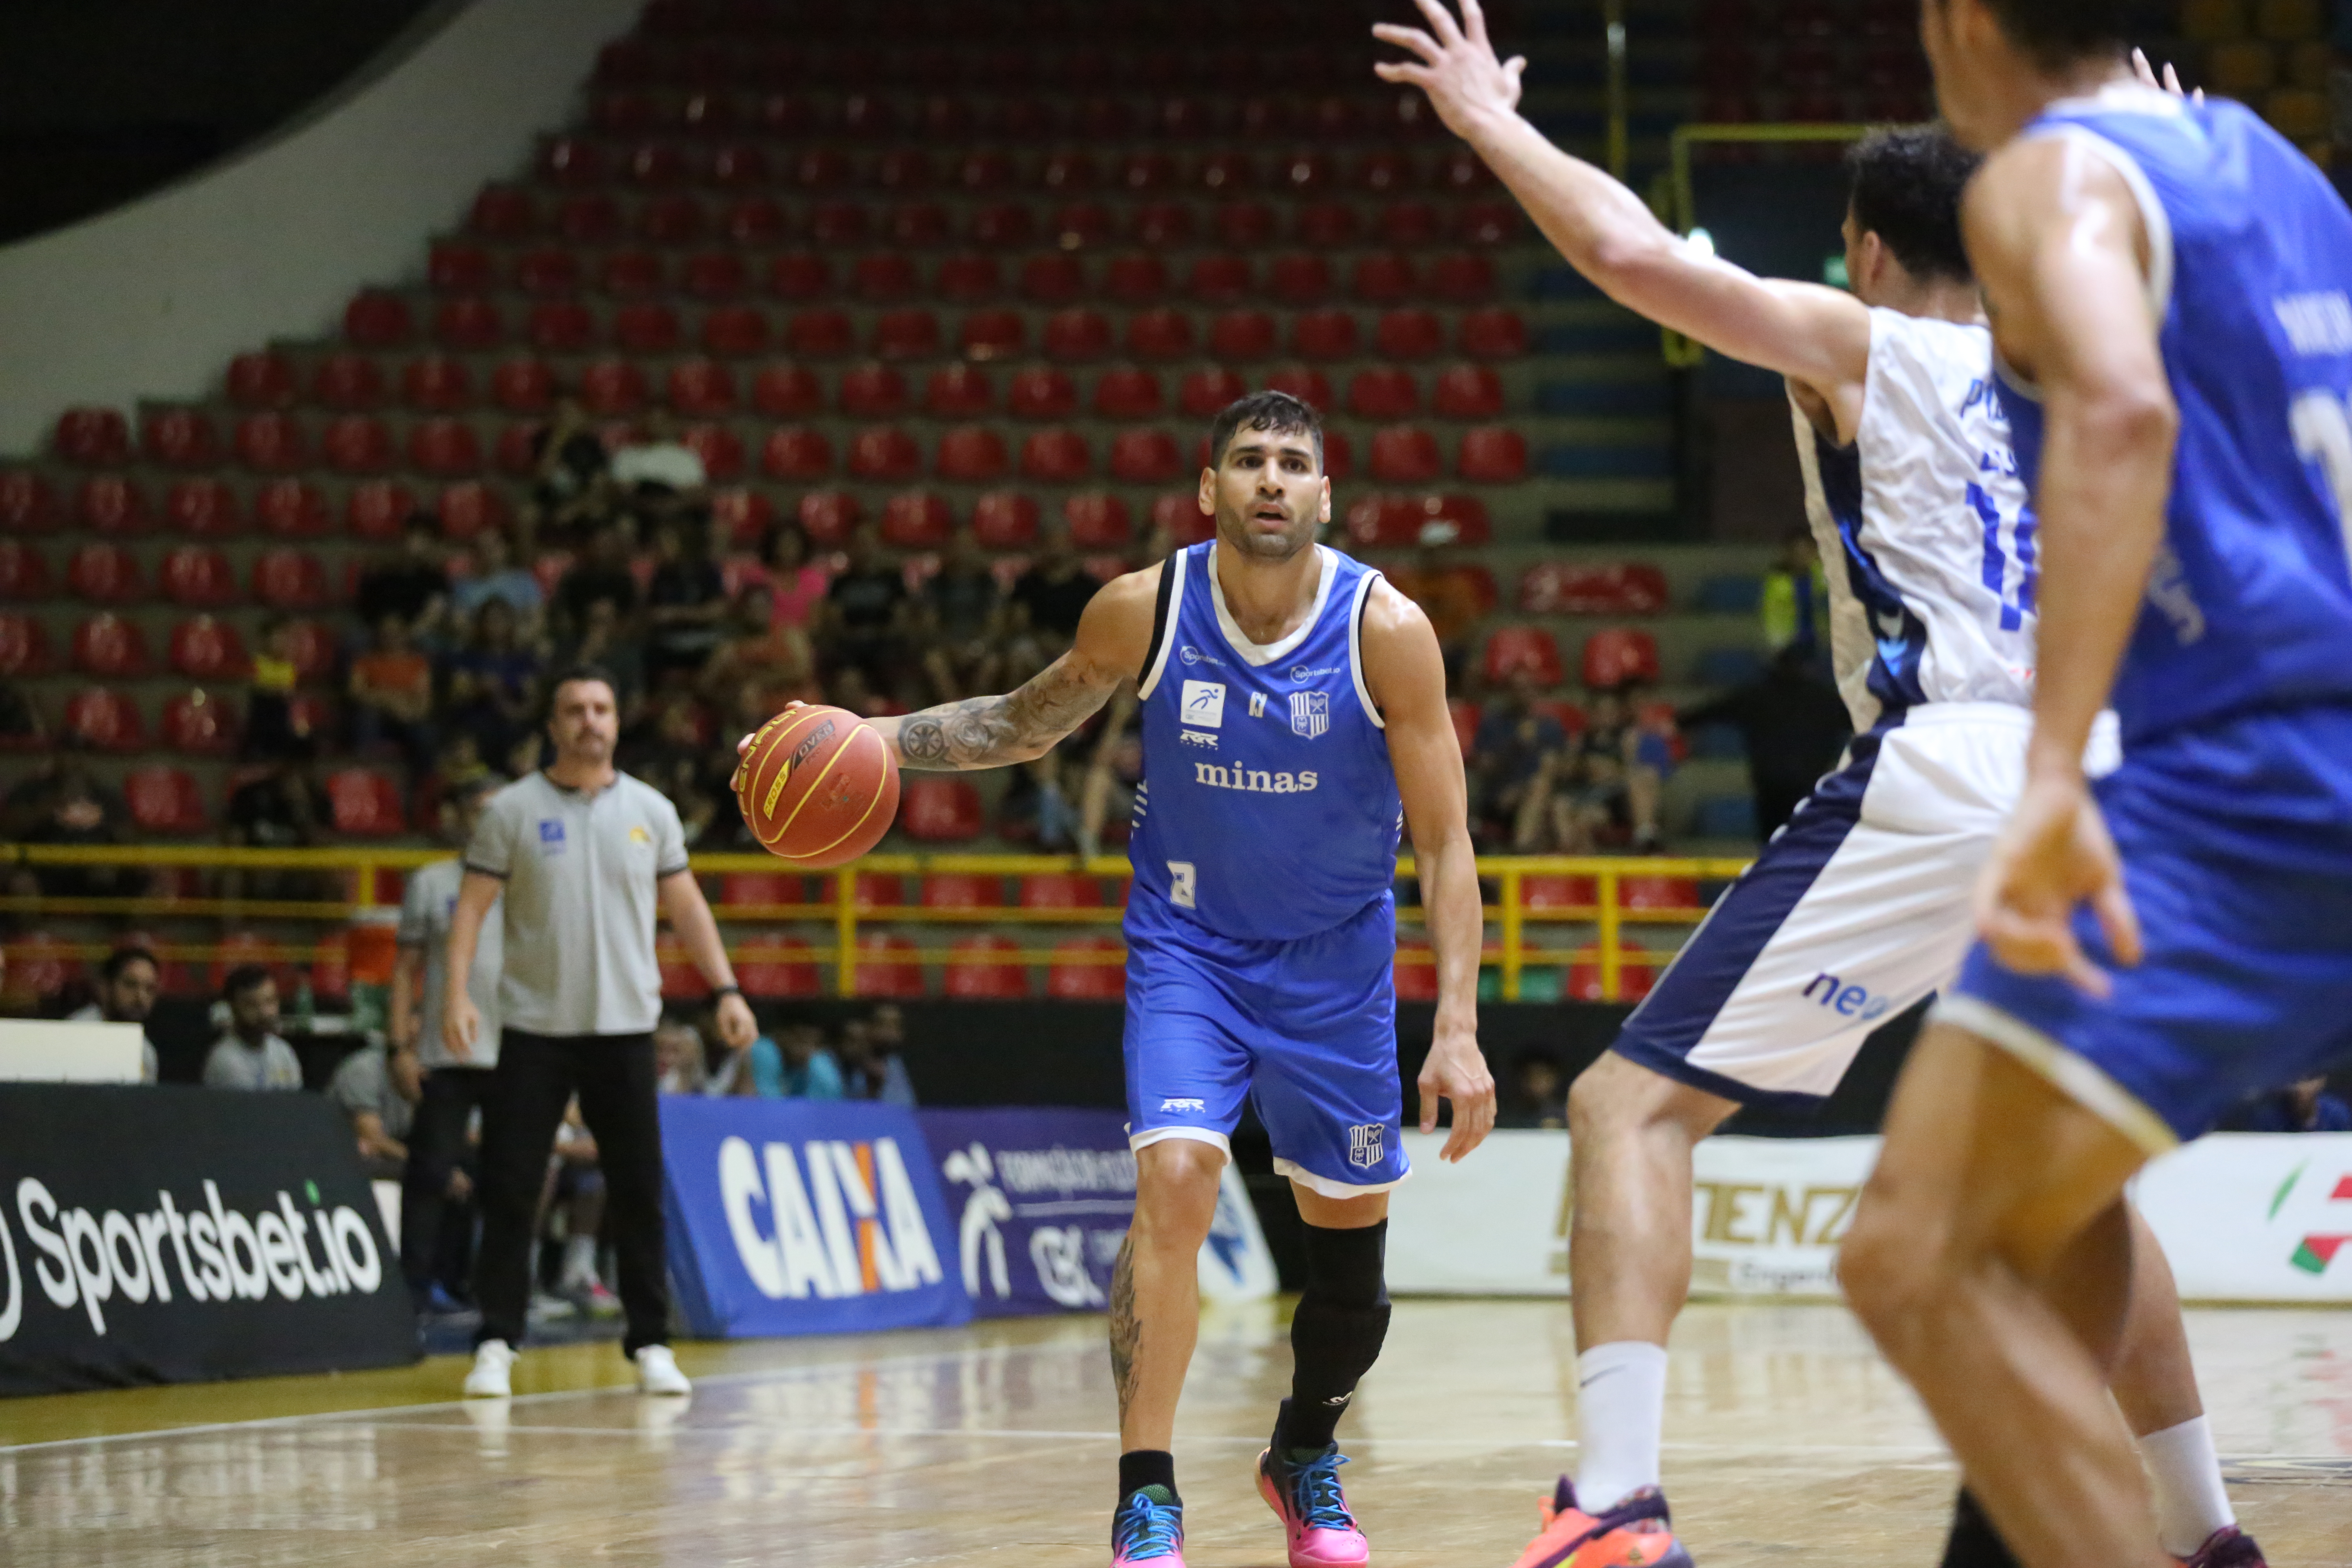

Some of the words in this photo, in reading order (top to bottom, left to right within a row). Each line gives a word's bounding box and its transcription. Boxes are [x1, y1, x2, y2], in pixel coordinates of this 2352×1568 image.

[764, 771, 787, 816] CROSS
[1194, 760, 1318, 793] minas
[16, 1177, 382, 1336] Sportsbet.io
[718, 1135, 944, 1300] CAIXA
